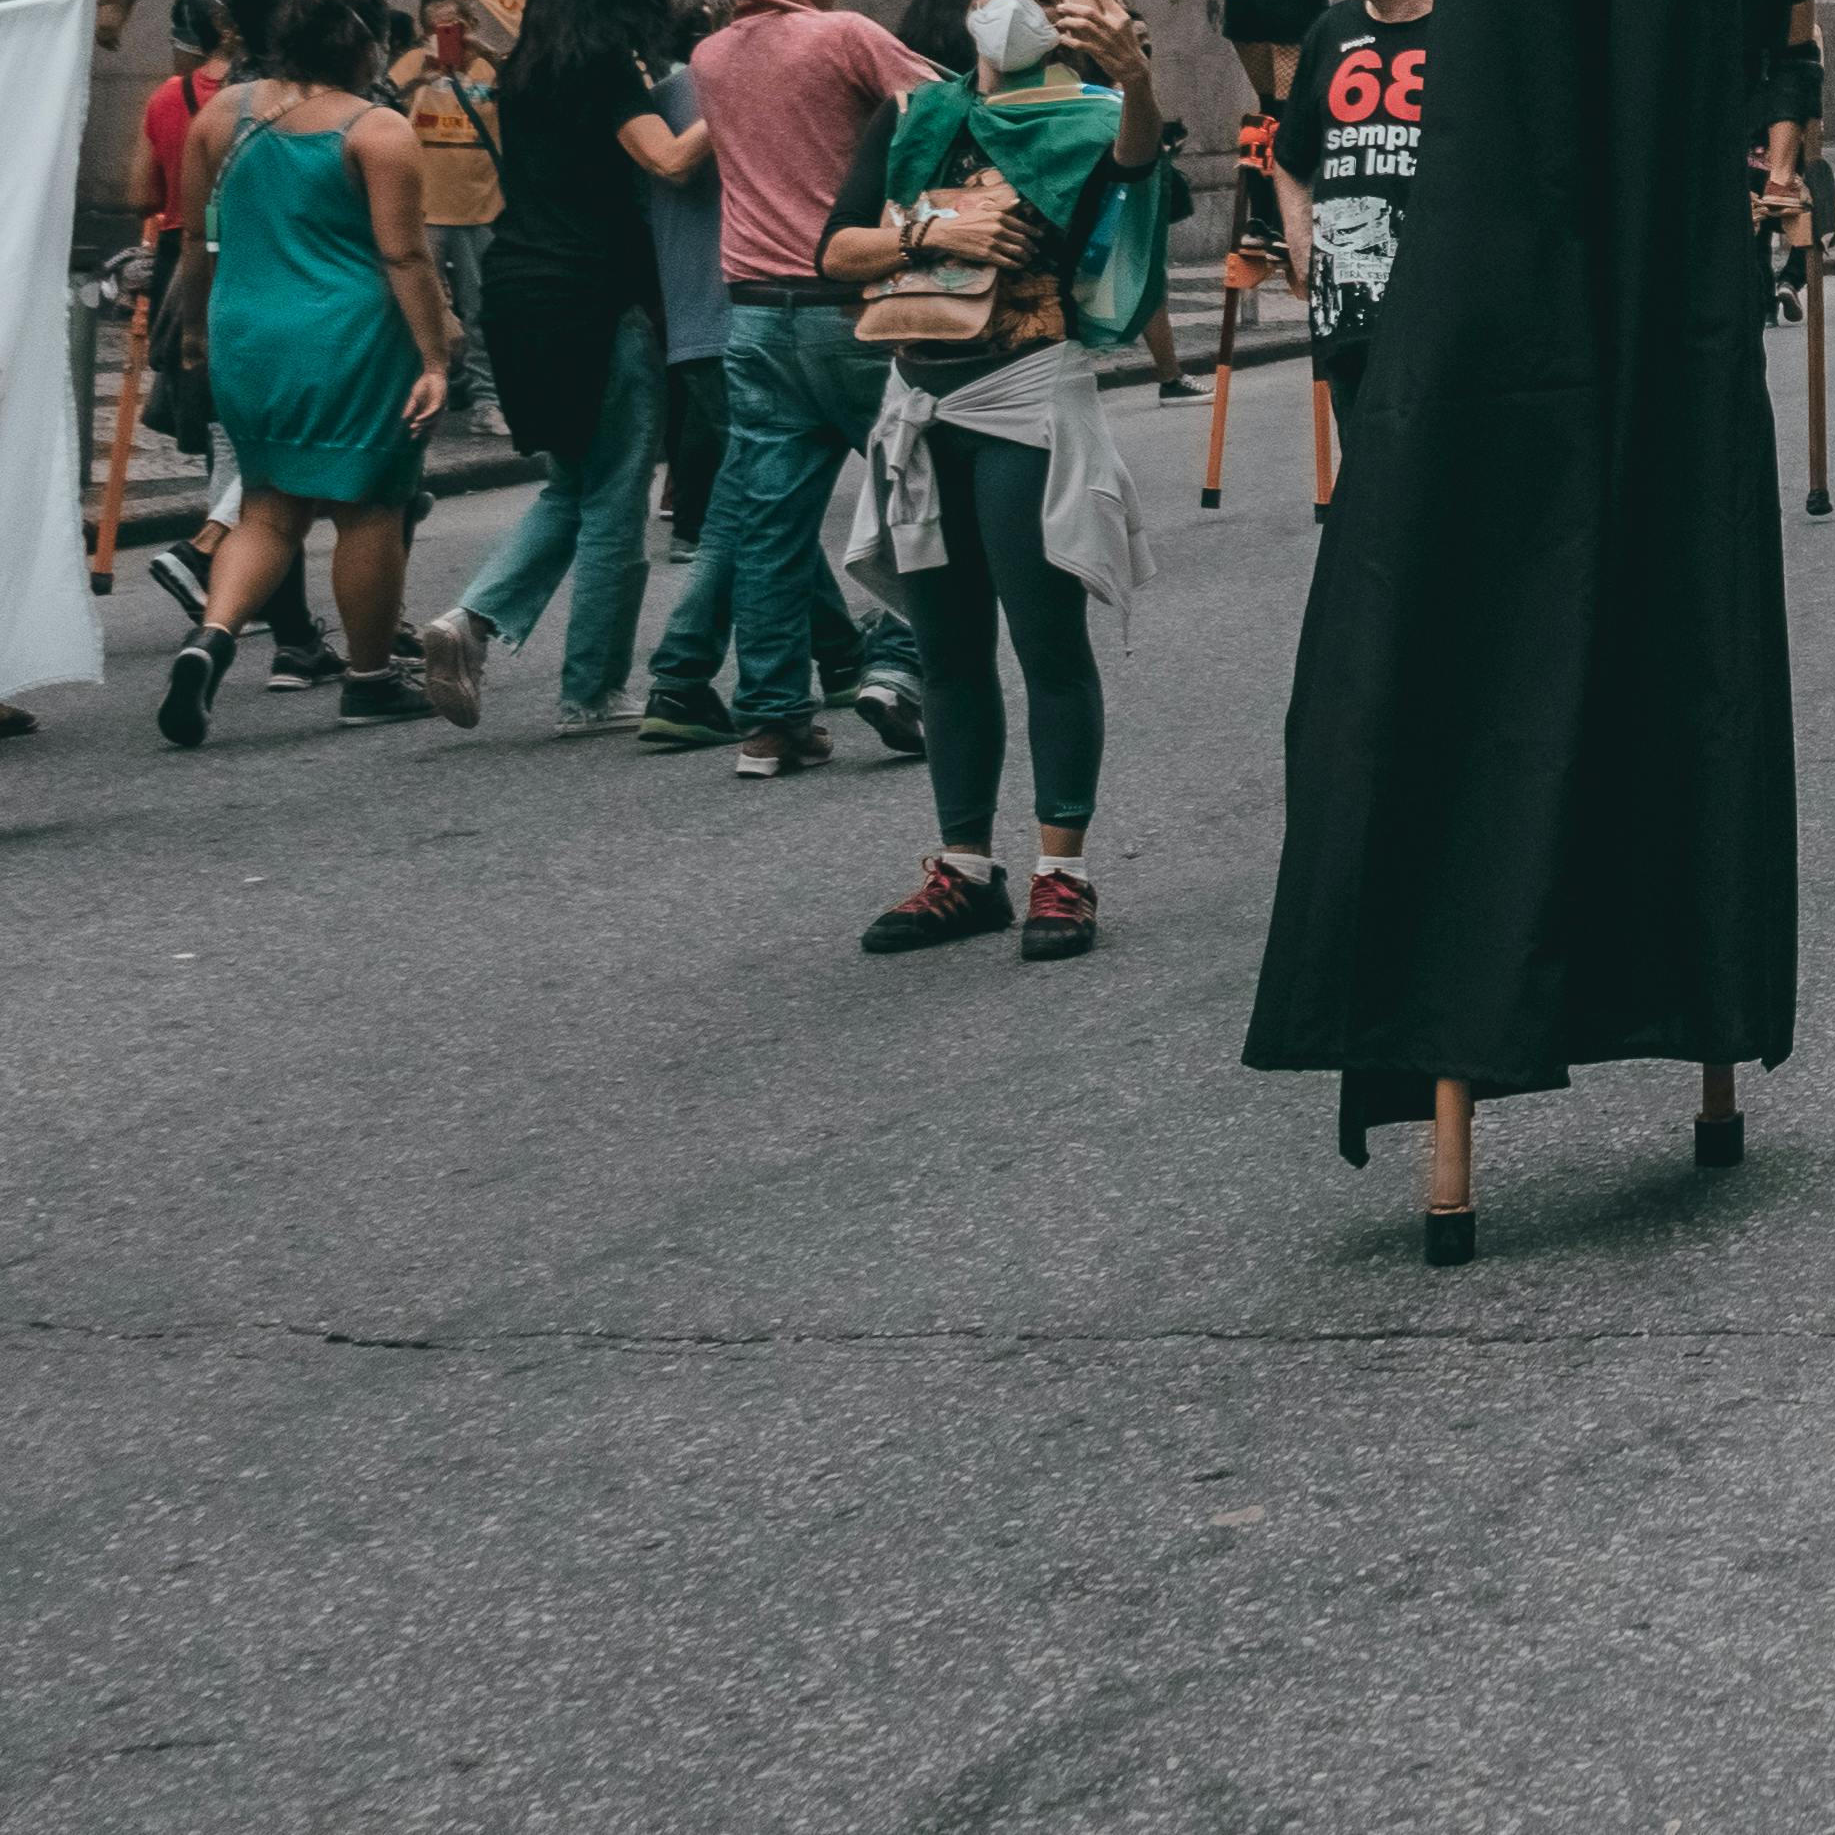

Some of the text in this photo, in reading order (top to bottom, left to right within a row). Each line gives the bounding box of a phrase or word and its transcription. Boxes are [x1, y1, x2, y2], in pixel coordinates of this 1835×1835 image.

[1328, 49, 1427, 123] 68
[1323, 148, 1418, 180] na lut
